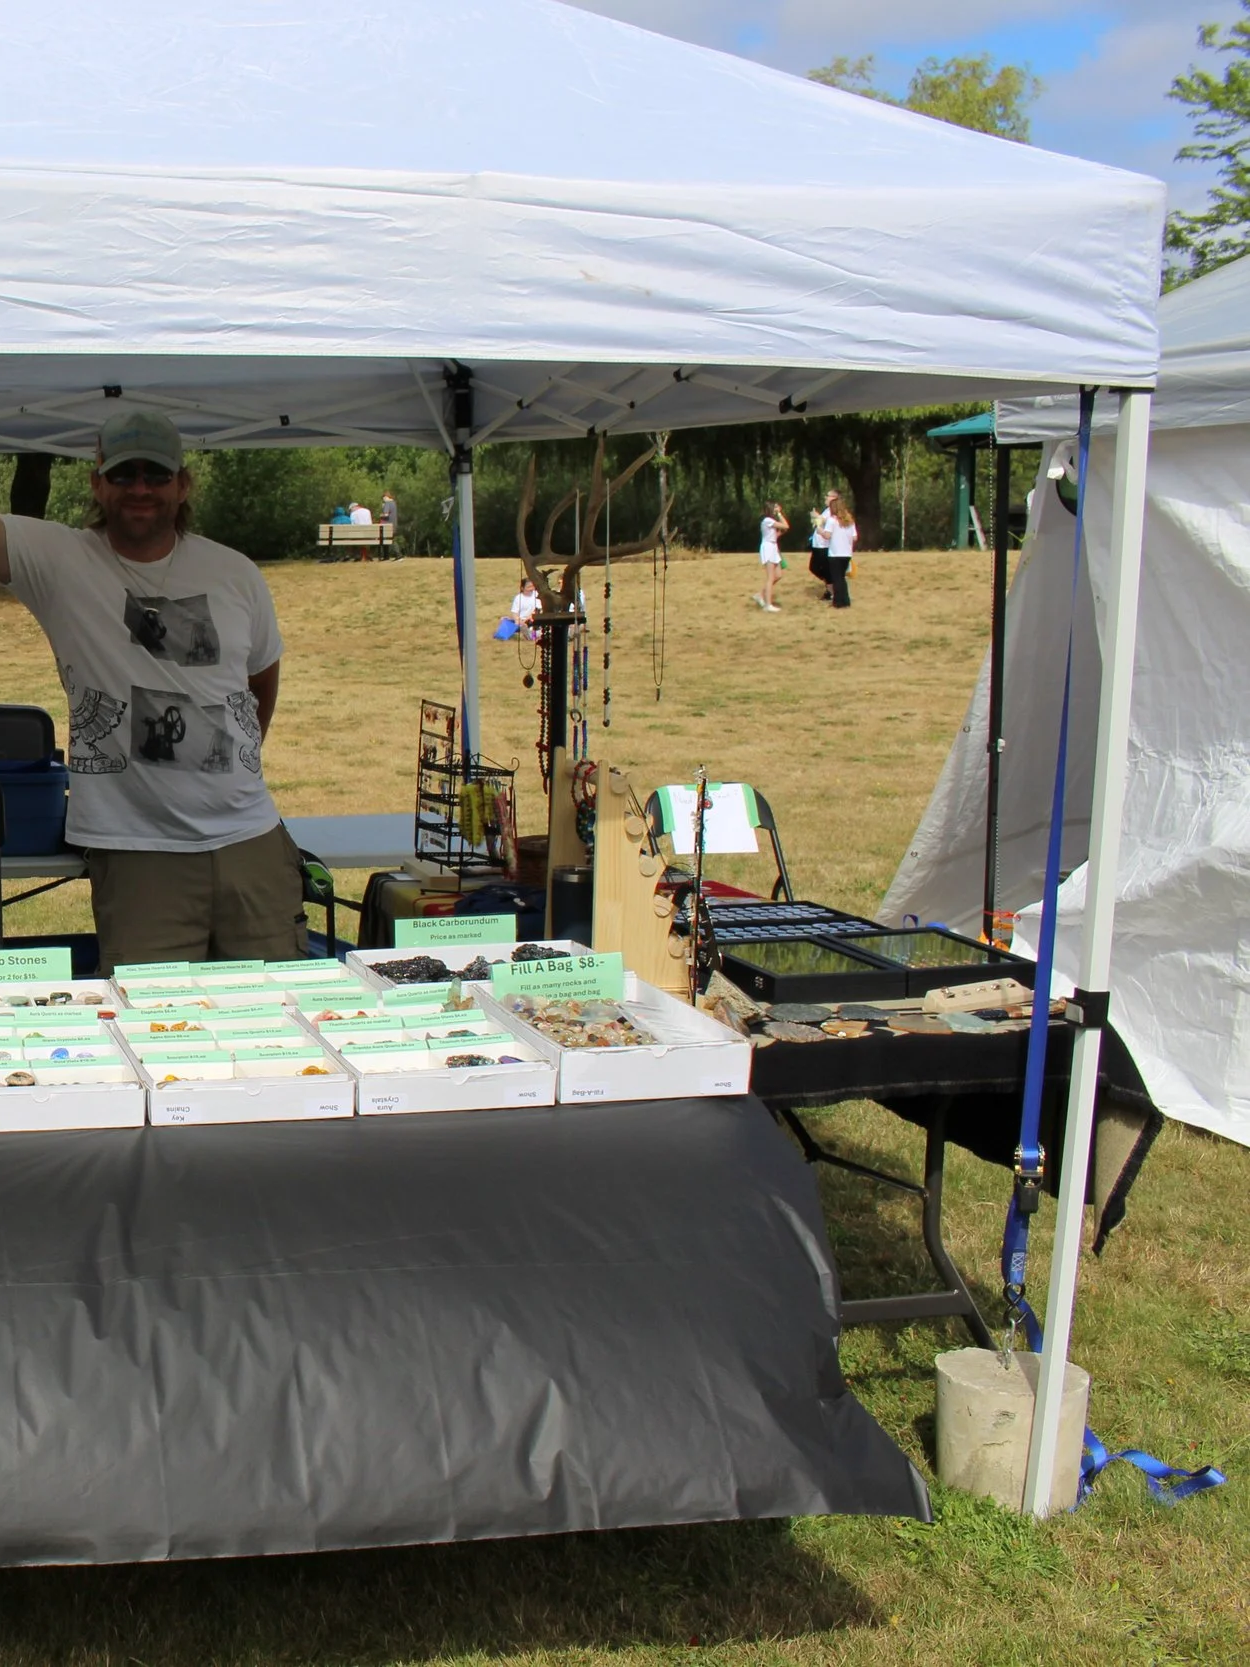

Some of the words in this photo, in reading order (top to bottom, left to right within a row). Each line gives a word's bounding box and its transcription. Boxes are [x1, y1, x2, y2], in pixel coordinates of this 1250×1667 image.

[412, 919, 437, 929] Black
[438, 917, 500, 928] Carborundum
[430, 933, 448, 941] Price
[458, 931, 482, 939] marked
[8, 955, 48, 966] Stones
[511, 963, 532, 976] Fill
[535, 962, 545, 973] A
[547, 959, 573, 974] Bag
[587, 988, 601, 996] bag
[517, 1091, 537, 1099] Show
[371, 1096, 400, 1104] Crystals
[319, 1104, 339, 1112] Show
[171, 1114, 185, 1122] Key
